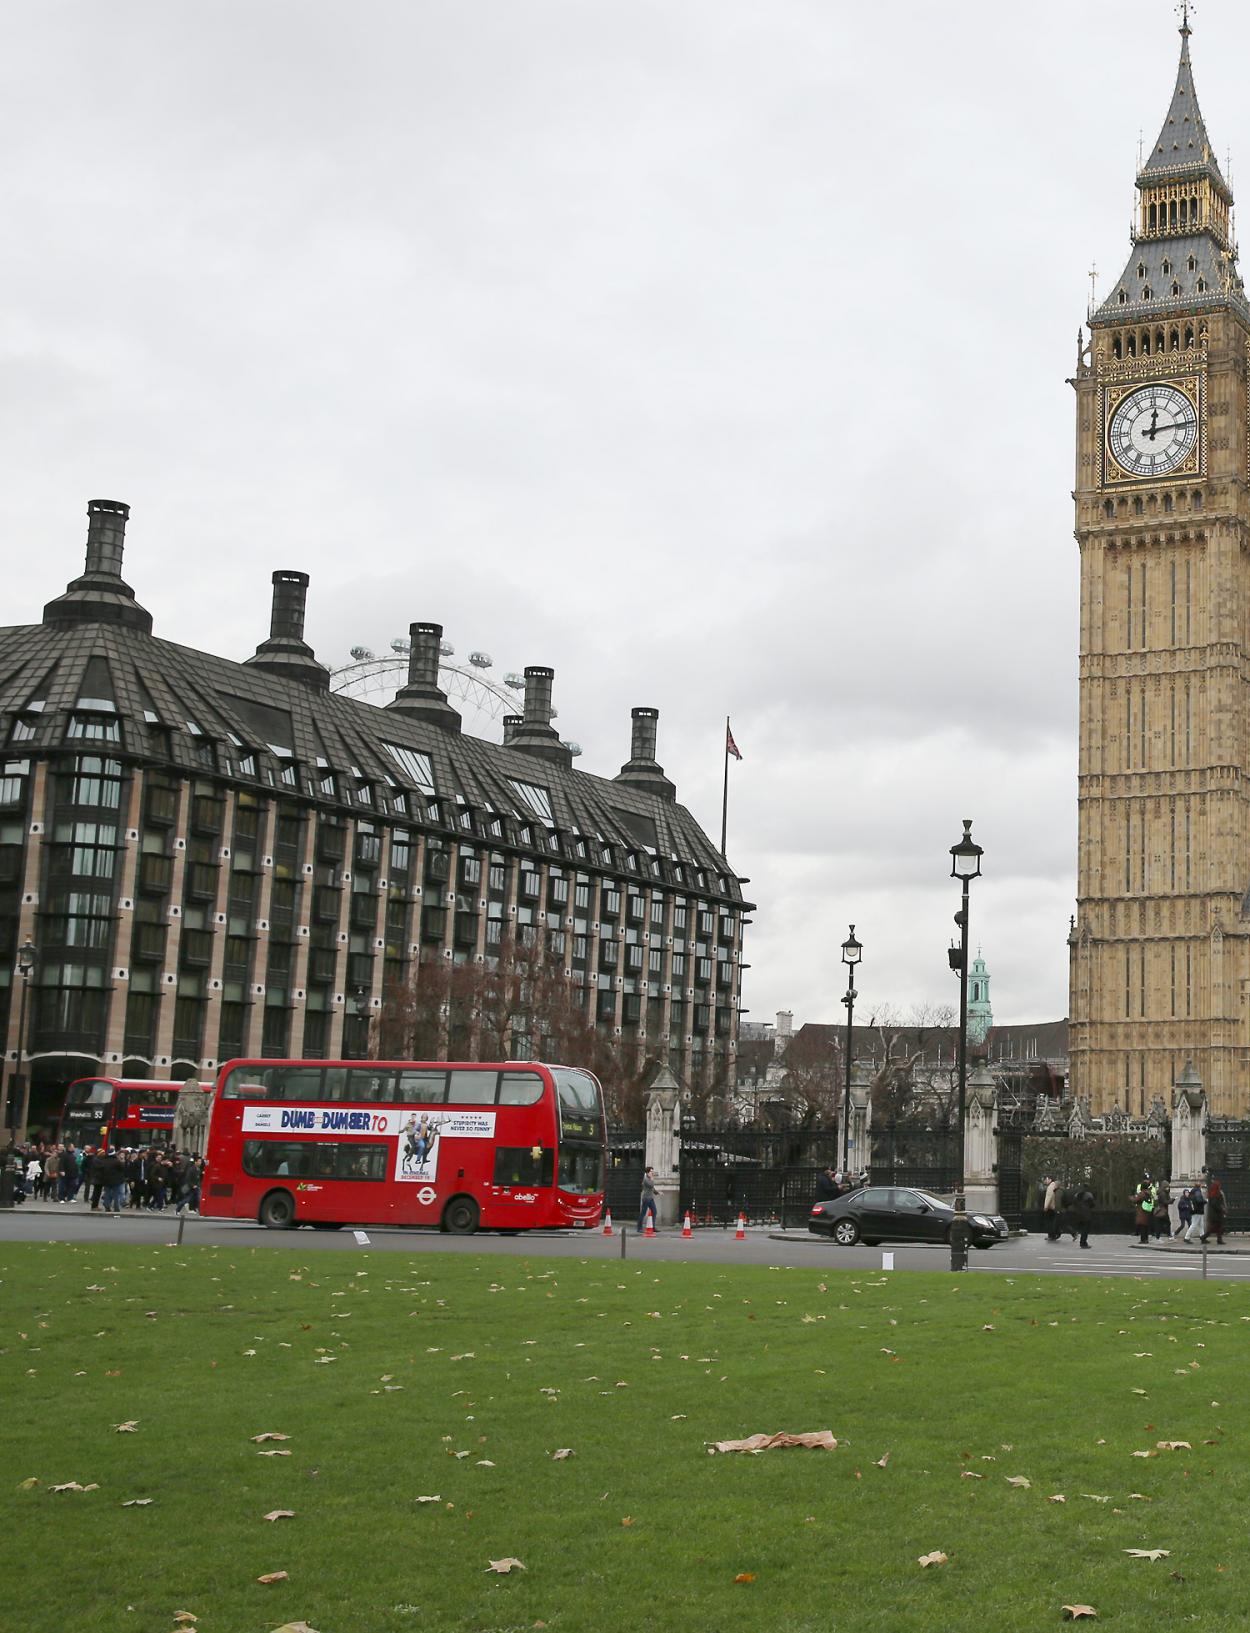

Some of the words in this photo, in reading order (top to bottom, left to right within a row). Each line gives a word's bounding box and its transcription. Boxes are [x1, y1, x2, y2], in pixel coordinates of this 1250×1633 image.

[94, 1110, 104, 1119] 53
[281, 1110, 315, 1129] DUMB
[321, 1112, 371, 1131] DUMBER
[371, 1114, 388, 1132] TO
